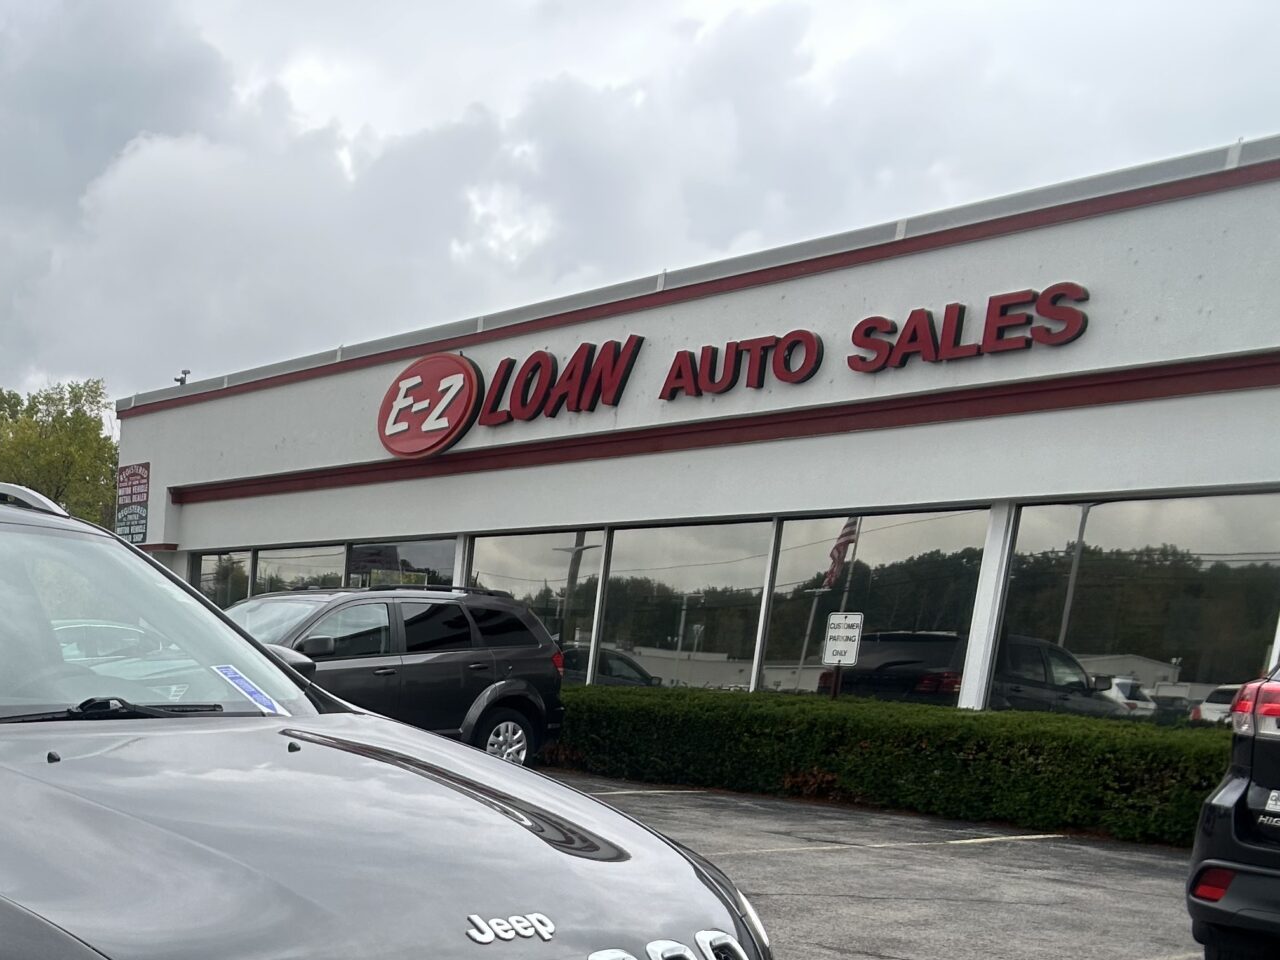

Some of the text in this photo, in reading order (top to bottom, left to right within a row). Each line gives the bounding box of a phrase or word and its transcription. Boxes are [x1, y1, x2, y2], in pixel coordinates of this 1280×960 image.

[384, 281, 1090, 436] E-Z LOAN AUTO SALES
[829, 622, 860, 630] CUSTOMER
[829, 635, 856, 643] PARKING
[832, 649, 848, 657] ONLY
[466, 912, 556, 945] Jeep
